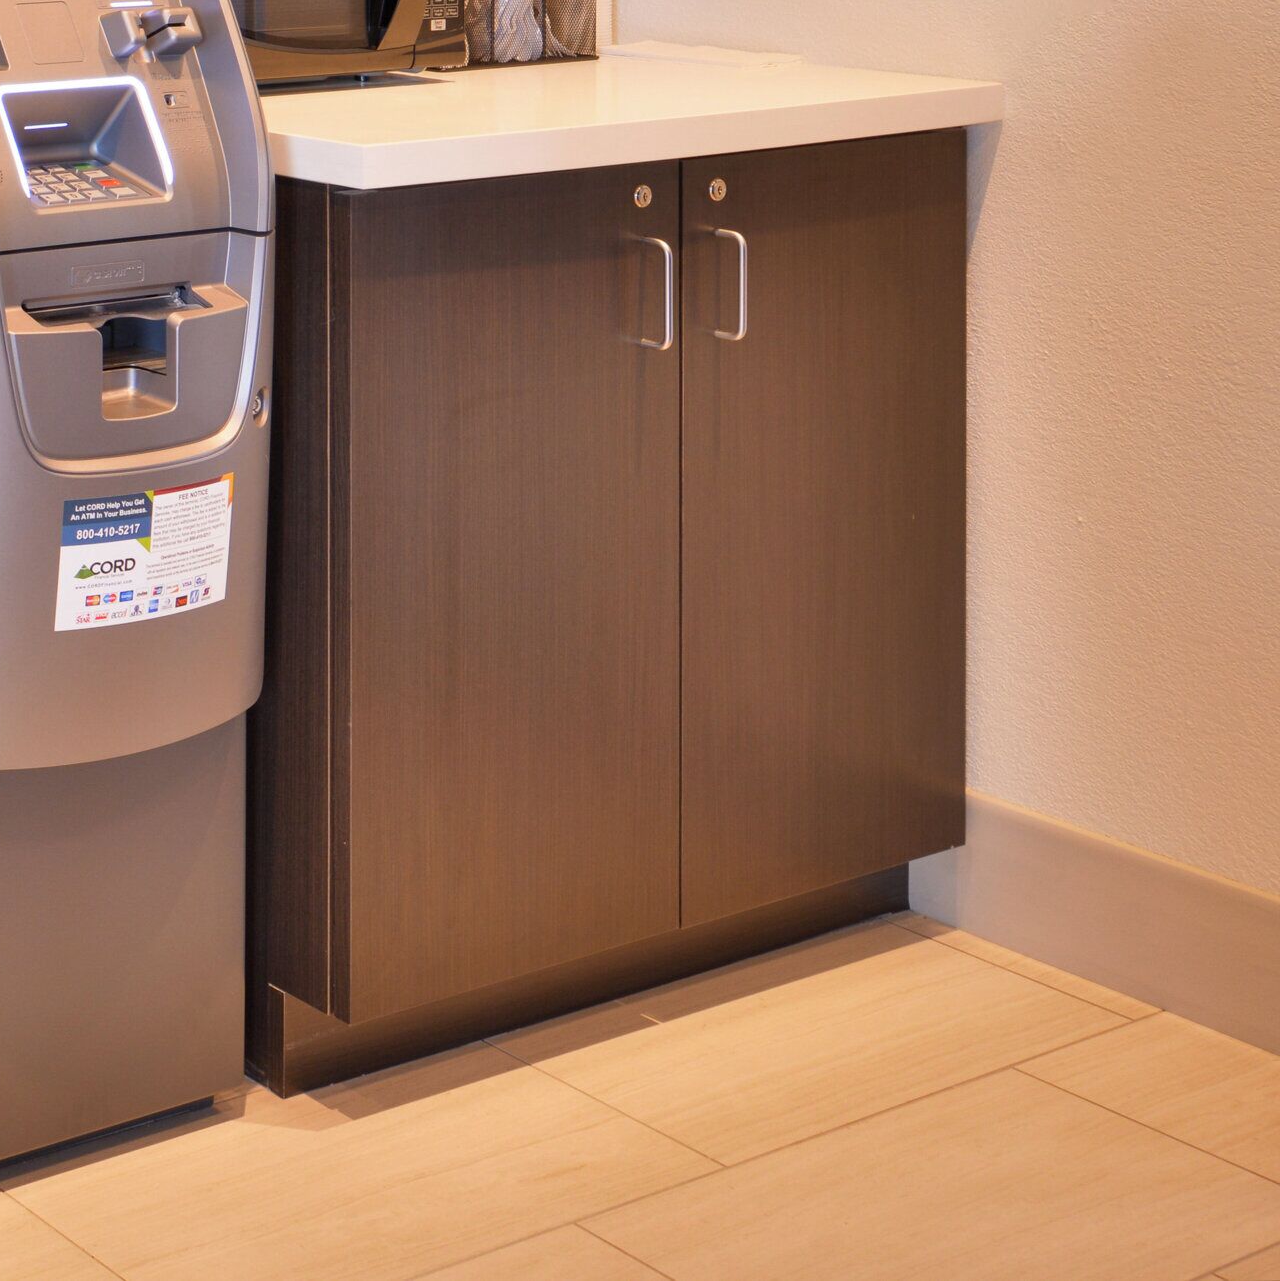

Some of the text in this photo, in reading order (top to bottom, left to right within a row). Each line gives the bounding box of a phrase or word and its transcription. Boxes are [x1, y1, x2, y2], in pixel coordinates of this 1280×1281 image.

[189, 488, 209, 498] NOTICE
[74, 505, 86, 513] Let
[86, 503, 106, 511] CORD
[106, 502, 121, 510] Help
[134, 498, 145, 506] Get
[80, 512, 96, 520] ATM
[96, 511, 103, 519] In
[103, 510, 119, 518] Your
[118, 507, 148, 516] Business.
[76, 523, 141, 540] 800-410-5217
[89, 557, 136, 576] CORD
